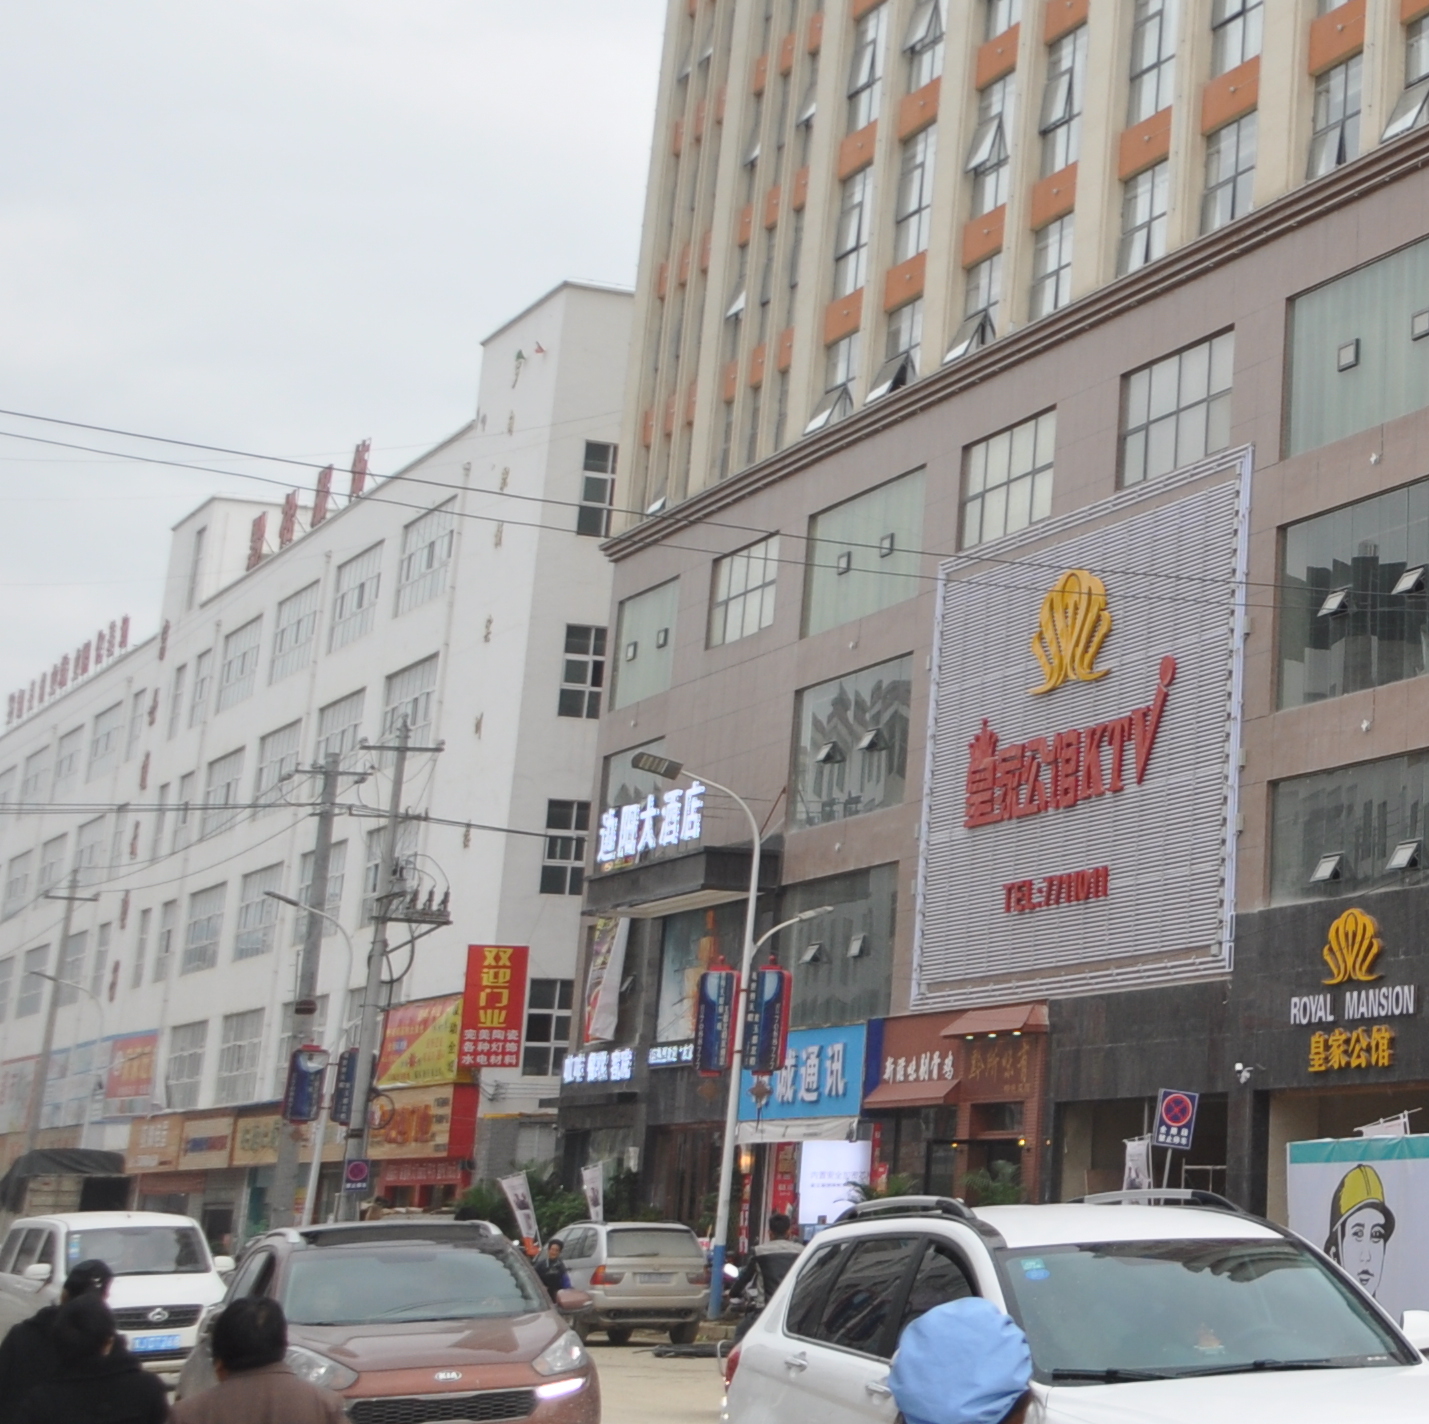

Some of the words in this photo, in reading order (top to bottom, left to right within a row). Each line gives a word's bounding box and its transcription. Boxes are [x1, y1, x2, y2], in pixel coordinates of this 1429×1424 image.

[597, 781, 706, 863] 边阳大酒店
[478, 947, 513, 1027] 双迎门业
[1290, 994, 1334, 1026] ROYAL
[1344, 985, 1415, 1018] MANSION
[1308, 1025, 1393, 1072] 皇家公馆
[437, 1372, 459, 1381] KIA
